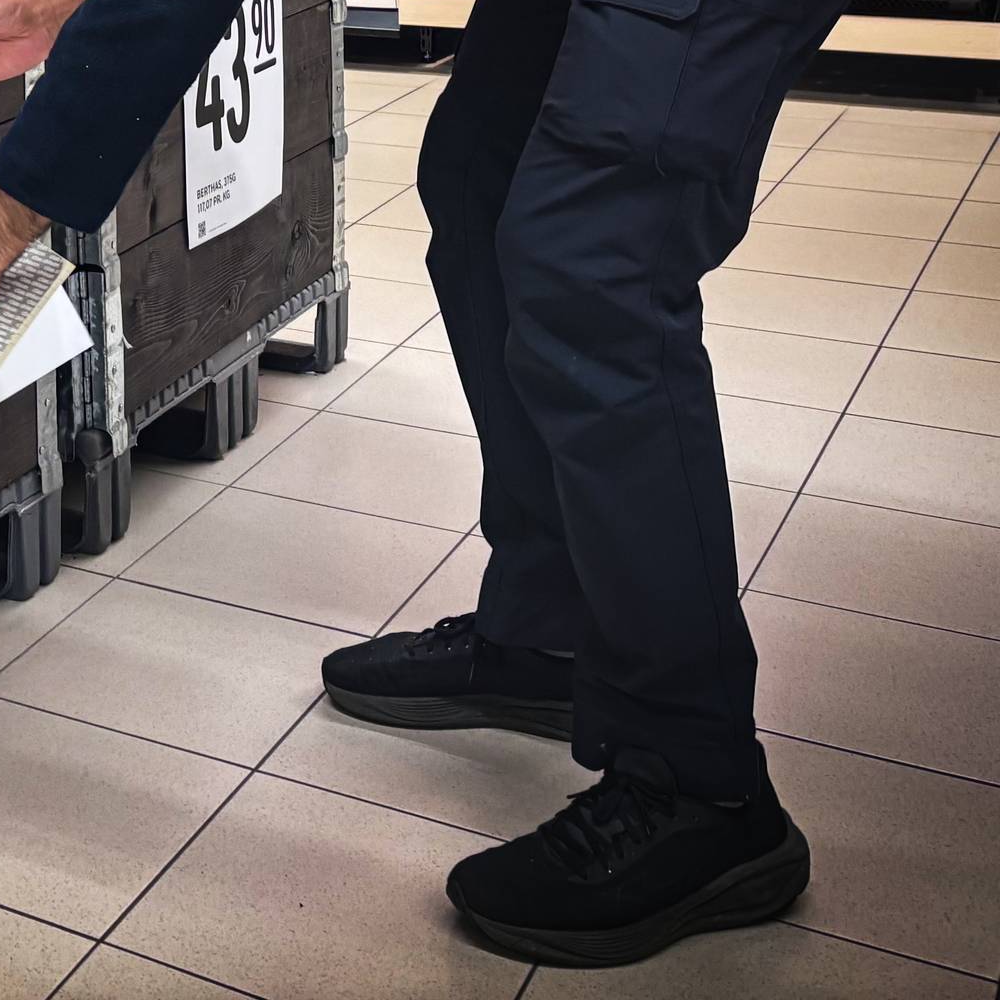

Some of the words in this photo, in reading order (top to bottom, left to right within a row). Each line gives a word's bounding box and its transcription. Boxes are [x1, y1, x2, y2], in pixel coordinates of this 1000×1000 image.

[195, 4, 251, 152] 43
[196, 179, 224, 199] BERTHAS,
[222, 189, 231, 201] KG
